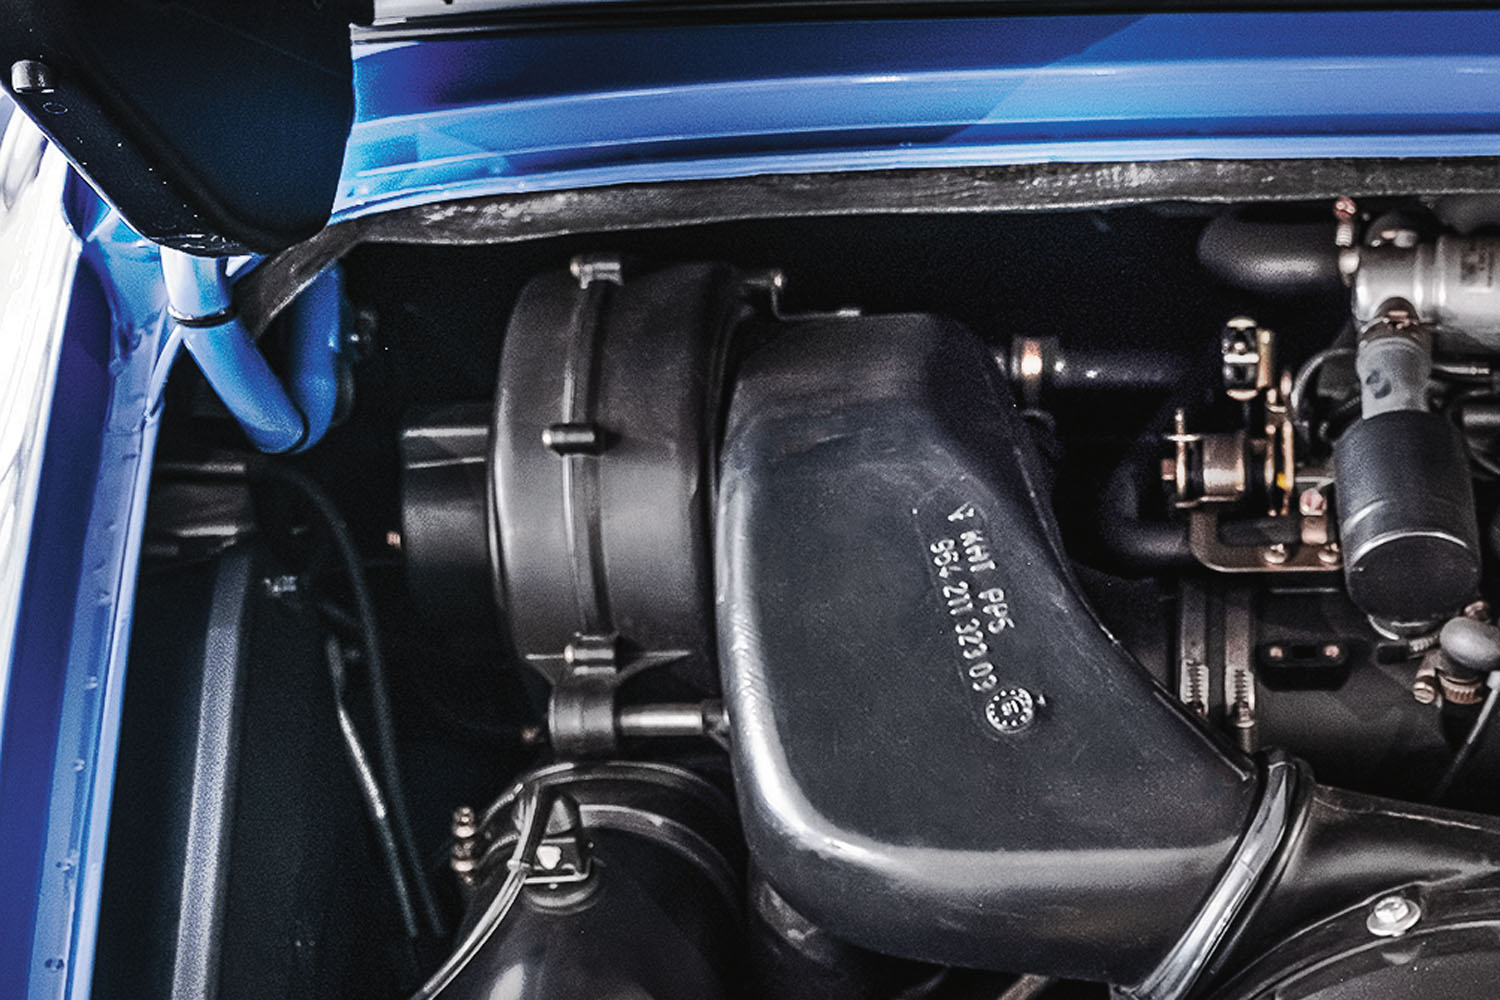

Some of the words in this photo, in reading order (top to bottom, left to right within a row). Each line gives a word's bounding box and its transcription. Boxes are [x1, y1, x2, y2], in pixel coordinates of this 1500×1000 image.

[942, 581, 974, 615] 211
[955, 618, 988, 659] 323
[969, 662, 997, 692] 03
